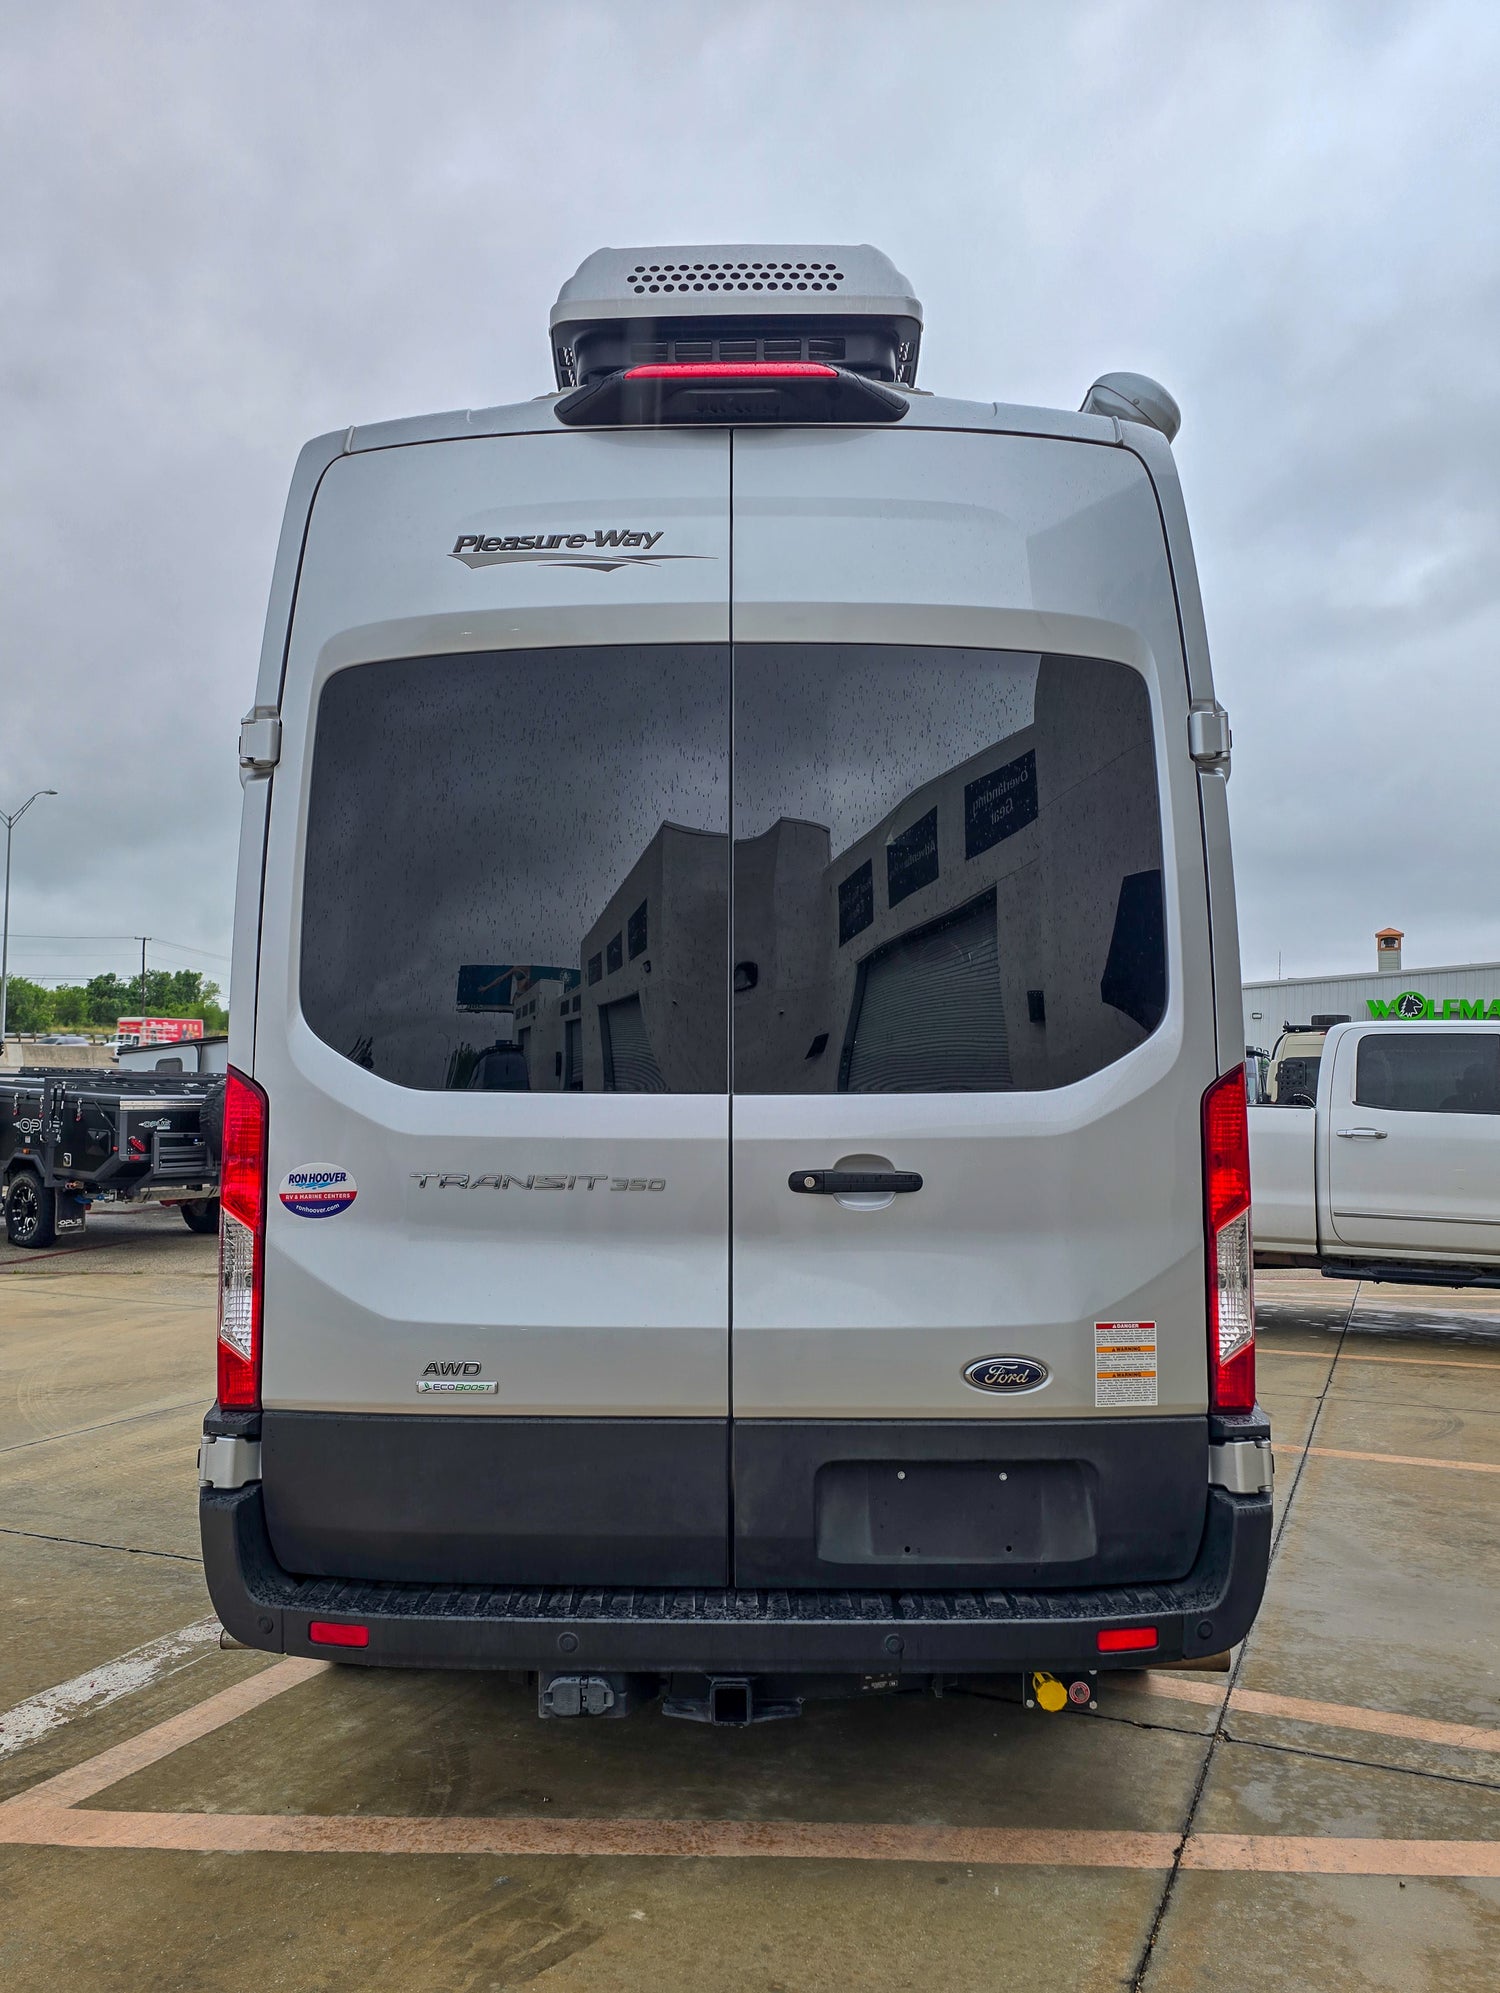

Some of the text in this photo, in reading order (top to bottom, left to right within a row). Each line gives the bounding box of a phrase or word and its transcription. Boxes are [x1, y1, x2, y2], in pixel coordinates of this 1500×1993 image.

[452, 528, 665, 553] Pleasure-Way
[288, 1172, 347, 1184] RON HOOVER
[409, 1173, 667, 1192] TRANSIT 350
[295, 1203, 340, 1213] ronhoover.com
[421, 1361, 482, 1376] AWD
[984, 1364, 1030, 1384] Ford
[433, 1383, 493, 1392] ECOBOOST
